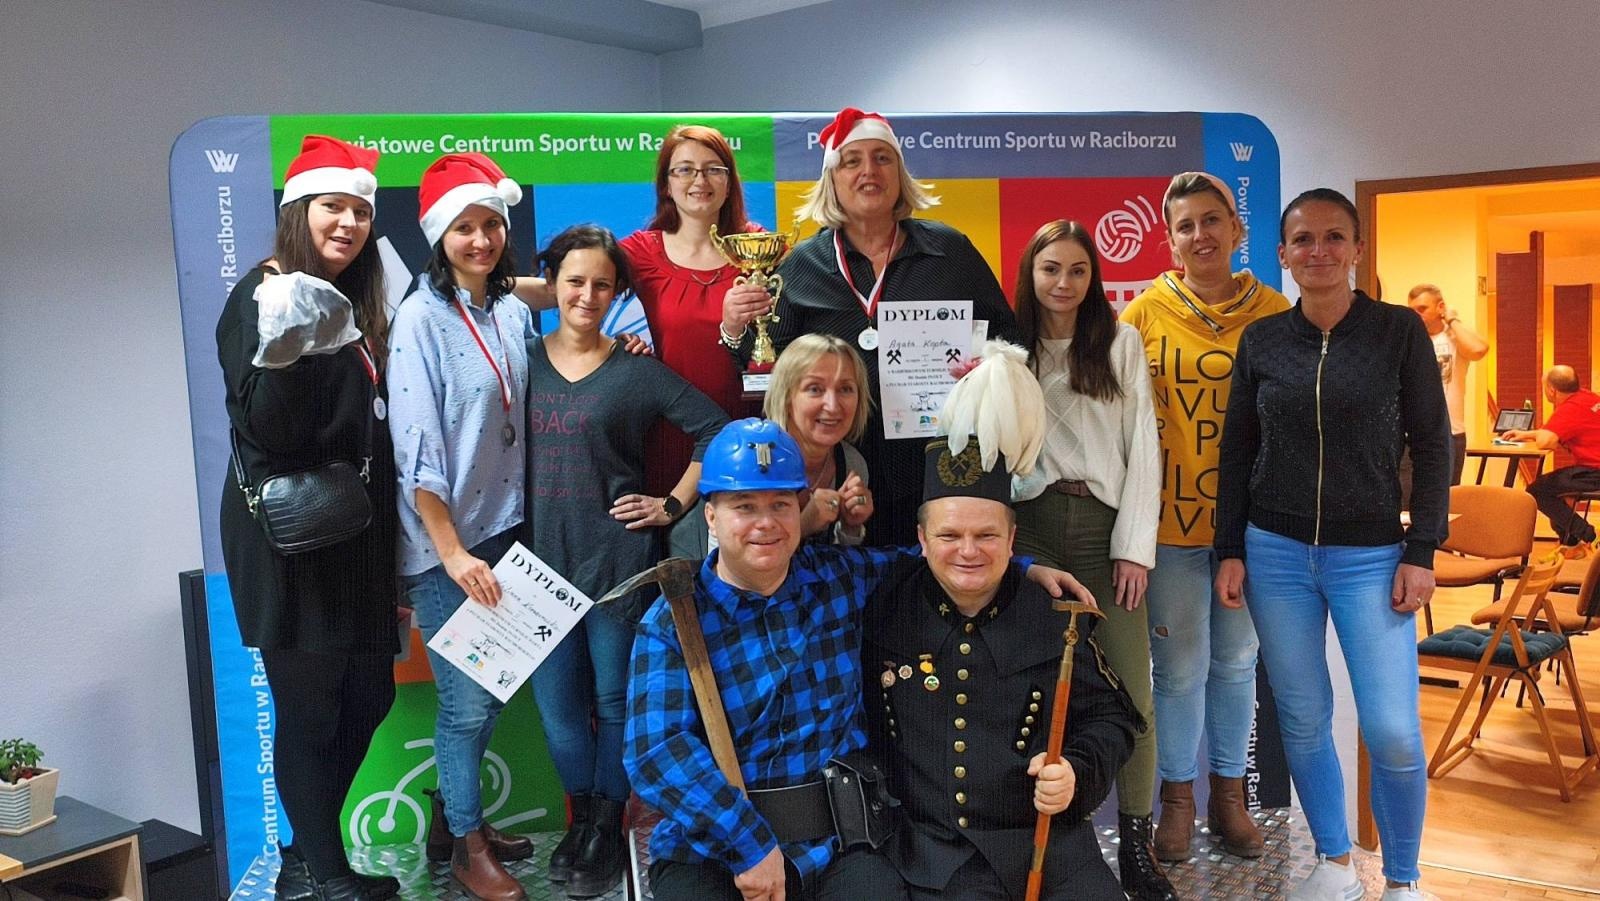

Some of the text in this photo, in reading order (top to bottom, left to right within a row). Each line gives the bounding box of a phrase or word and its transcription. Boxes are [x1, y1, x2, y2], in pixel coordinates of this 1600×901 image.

[439, 134, 534, 153] Centrum
[539, 133, 611, 156] Sportu
[615, 137, 634, 151] w
[919, 131, 1000, 149] Centrum
[1005, 131, 1066, 151] Sportu
[1070, 135, 1086, 148] w
[1090, 131, 1177, 148] Raciborzu
[217, 186, 237, 277] Raciborzu
[884, 307, 966, 322] DYPLOM
[510, 553, 583, 612] DYPLOM
[256, 691, 269, 708] w
[262, 778, 280, 857] Centrum
